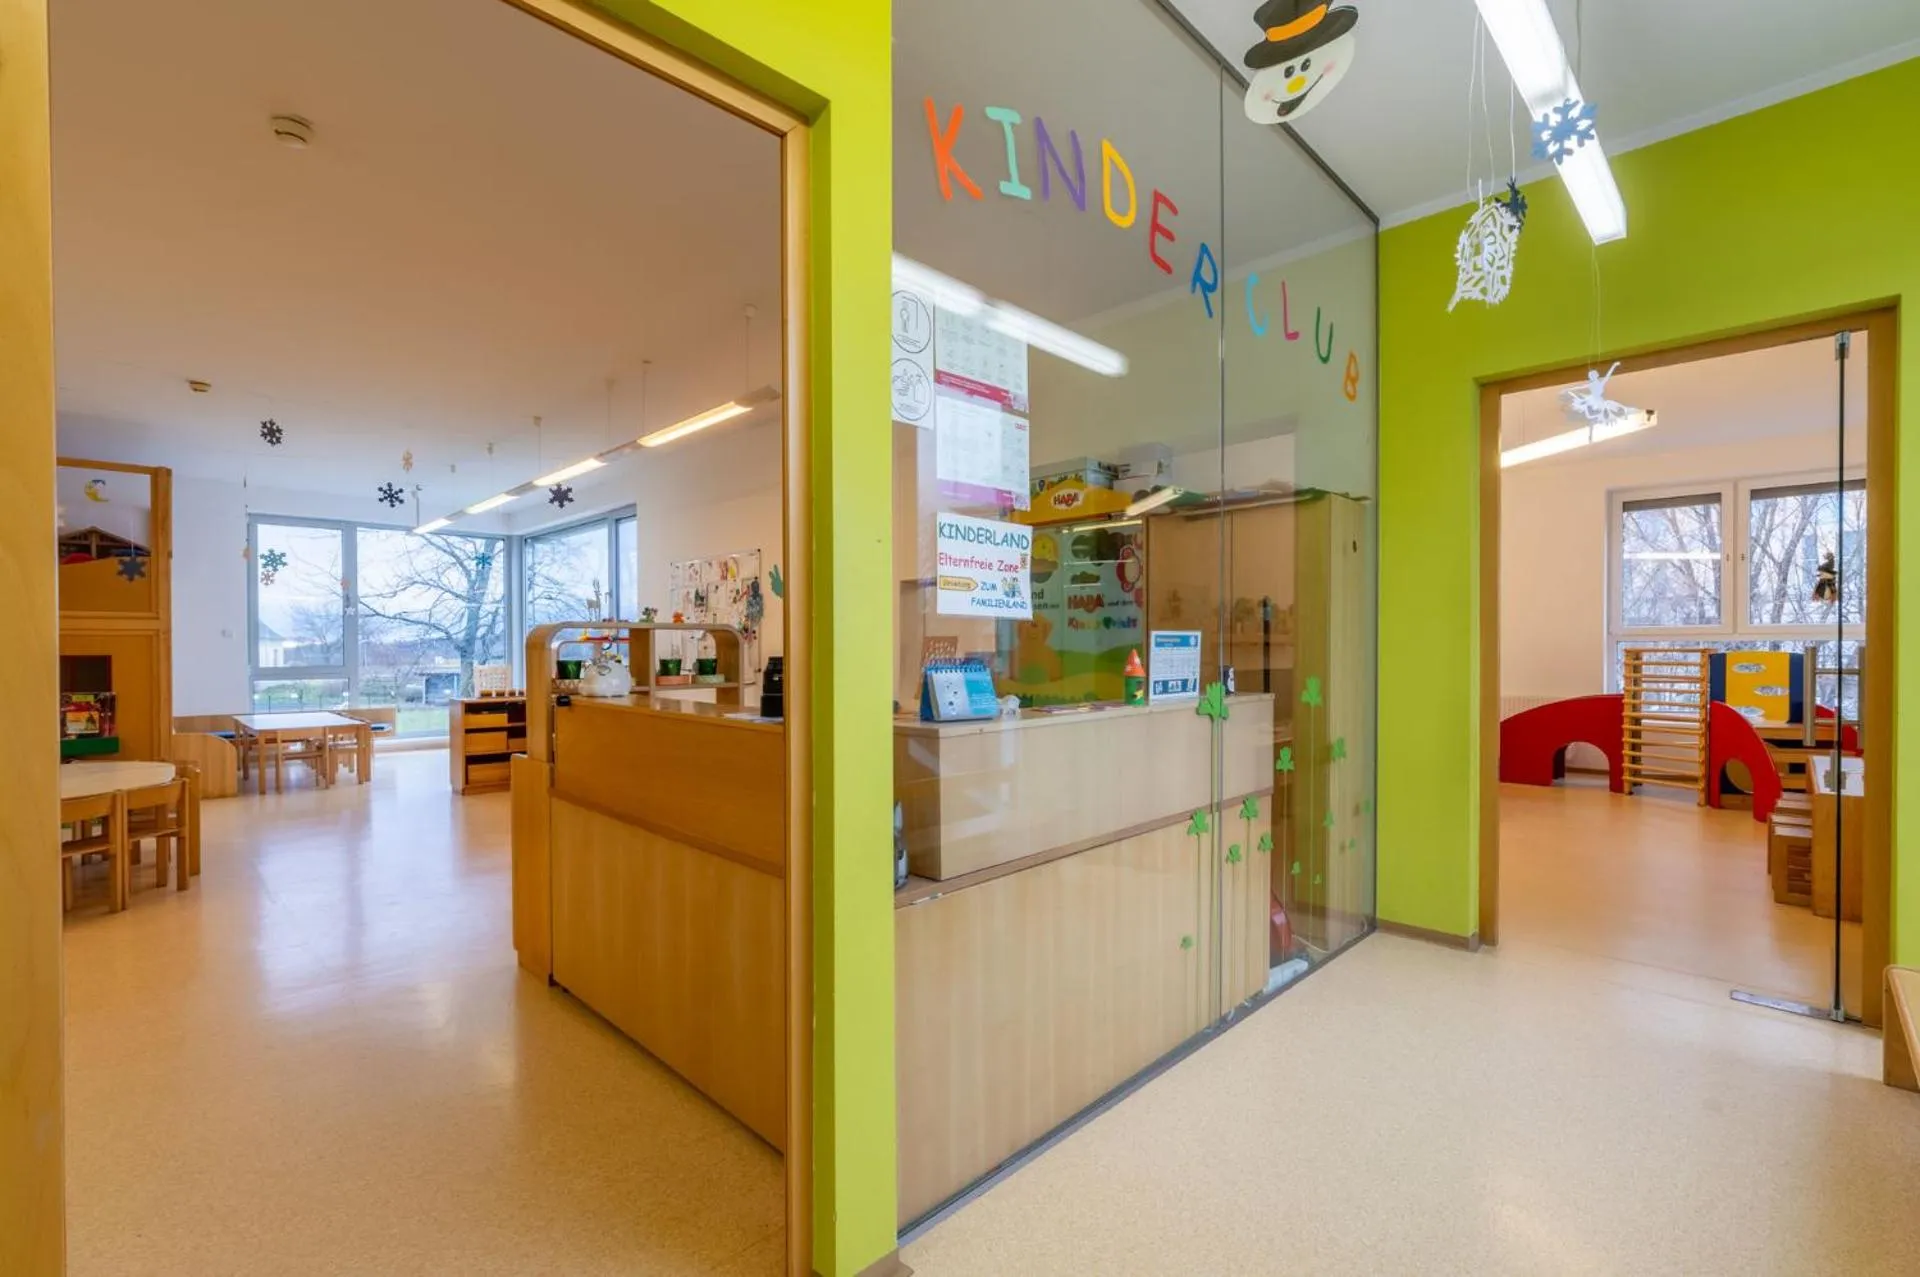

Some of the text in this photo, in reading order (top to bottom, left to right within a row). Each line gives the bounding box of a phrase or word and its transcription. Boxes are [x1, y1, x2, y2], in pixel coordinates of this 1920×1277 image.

[938, 521, 1030, 551] KINDERLAND
[938, 552, 1020, 574] Elternfreie Zone
[971, 597, 1028, 610] FAMILIENLAND
